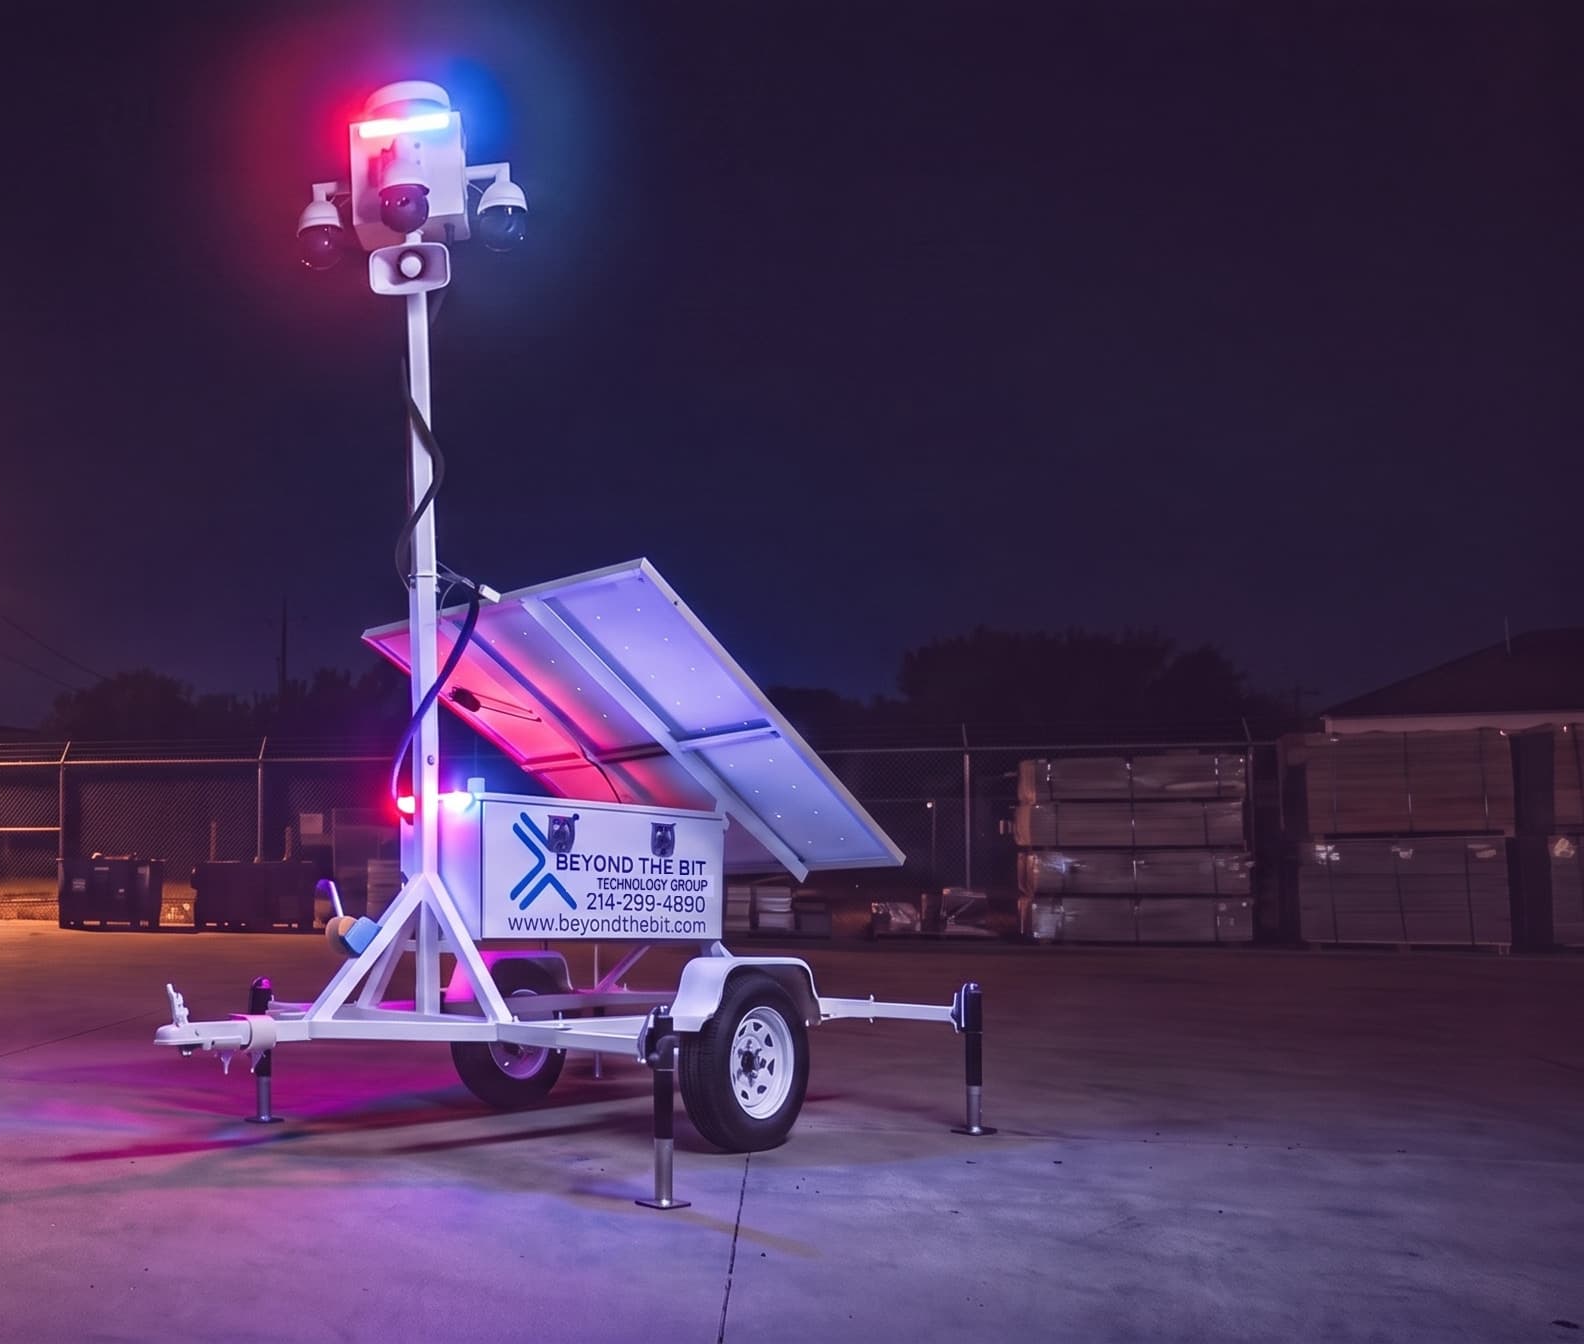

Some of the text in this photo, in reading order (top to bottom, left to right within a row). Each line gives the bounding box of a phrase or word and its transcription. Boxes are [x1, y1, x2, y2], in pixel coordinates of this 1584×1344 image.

[556, 854, 706, 876] BEYOND THE BIT
[597, 877, 708, 892] TECHNOLOGY GROUP
[586, 893, 705, 913] 214-299-4890
[508, 914, 706, 936] www.beyondthebit.com
